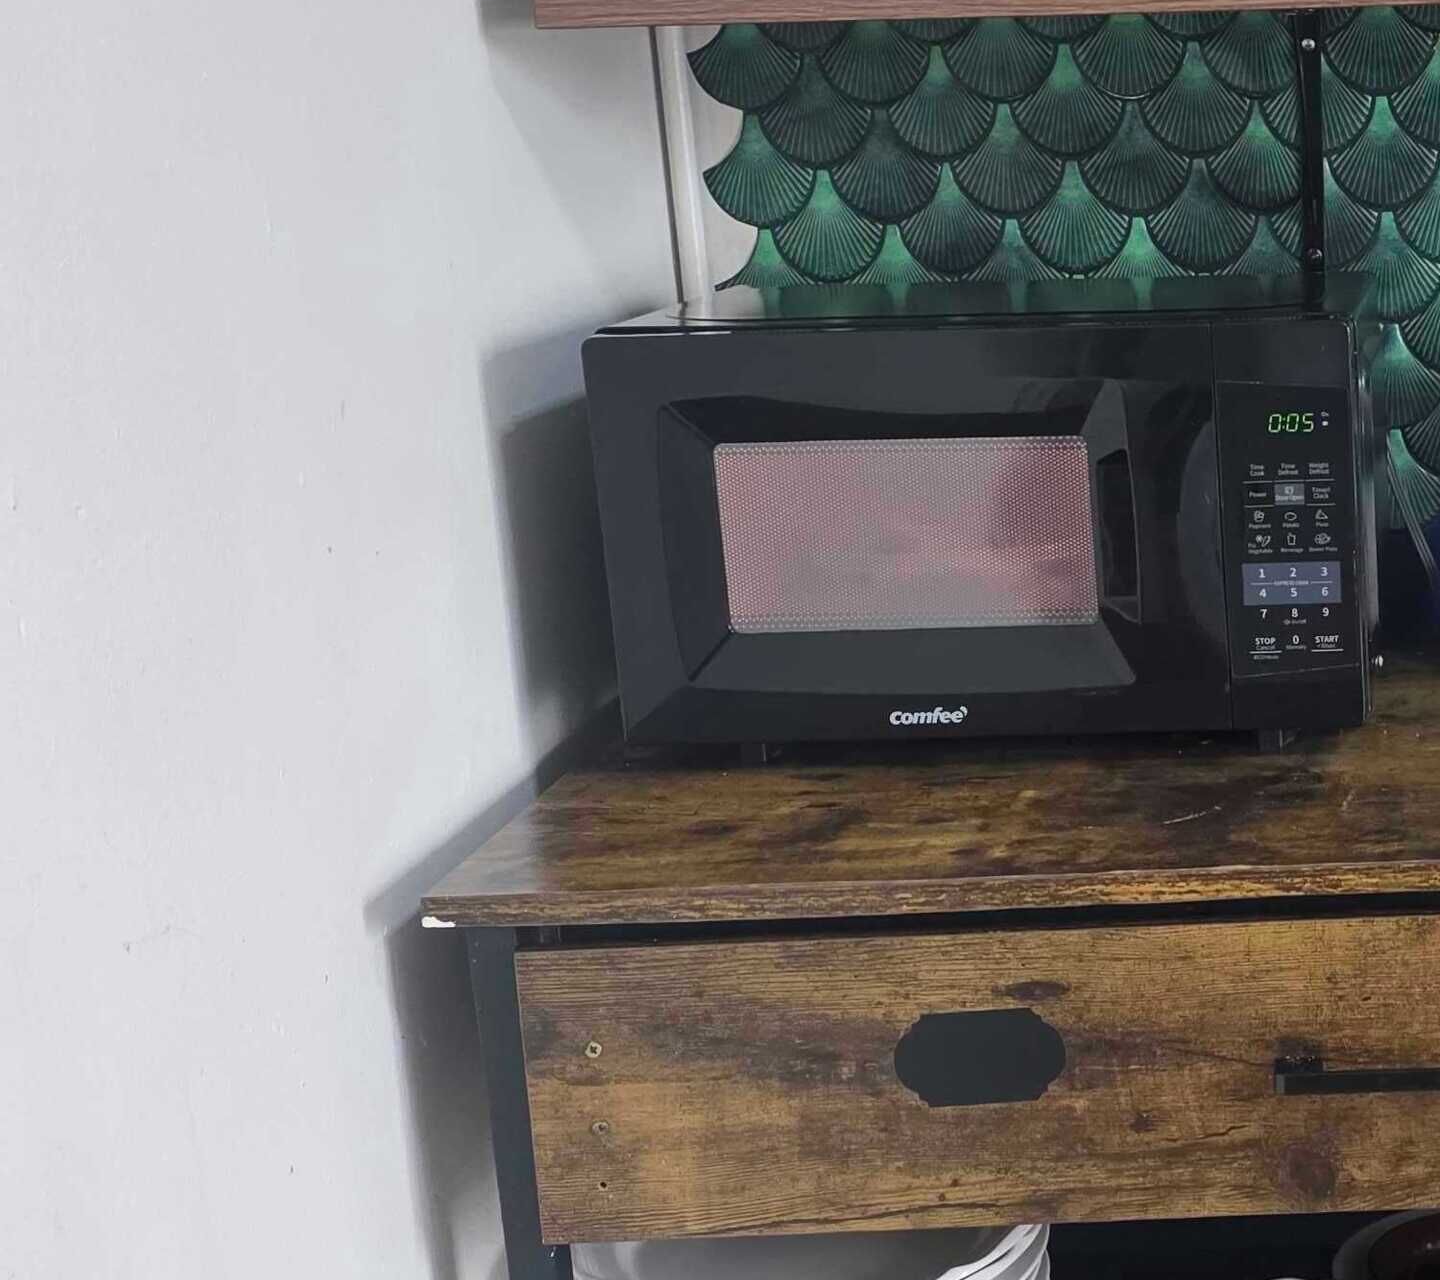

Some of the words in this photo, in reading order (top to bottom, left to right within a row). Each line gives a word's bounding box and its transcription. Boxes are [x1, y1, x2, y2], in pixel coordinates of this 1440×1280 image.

[1268, 412, 1314, 433] 0:05
[1258, 568, 1266, 578] 1
[1289, 567, 1297, 577] 2
[1320, 567, 1328, 577] 3
[1258, 588, 1267, 598] 4
[1290, 587, 1298, 597] 5
[1321, 587, 1329, 596] 6
[1260, 608, 1268, 619] 7
[1291, 607, 1299, 618] 8
[1322, 607, 1330, 617] 9
[1255, 637, 1277, 645] STOP
[1292, 634, 1300, 644] 0
[1314, 635, 1339, 643] START
